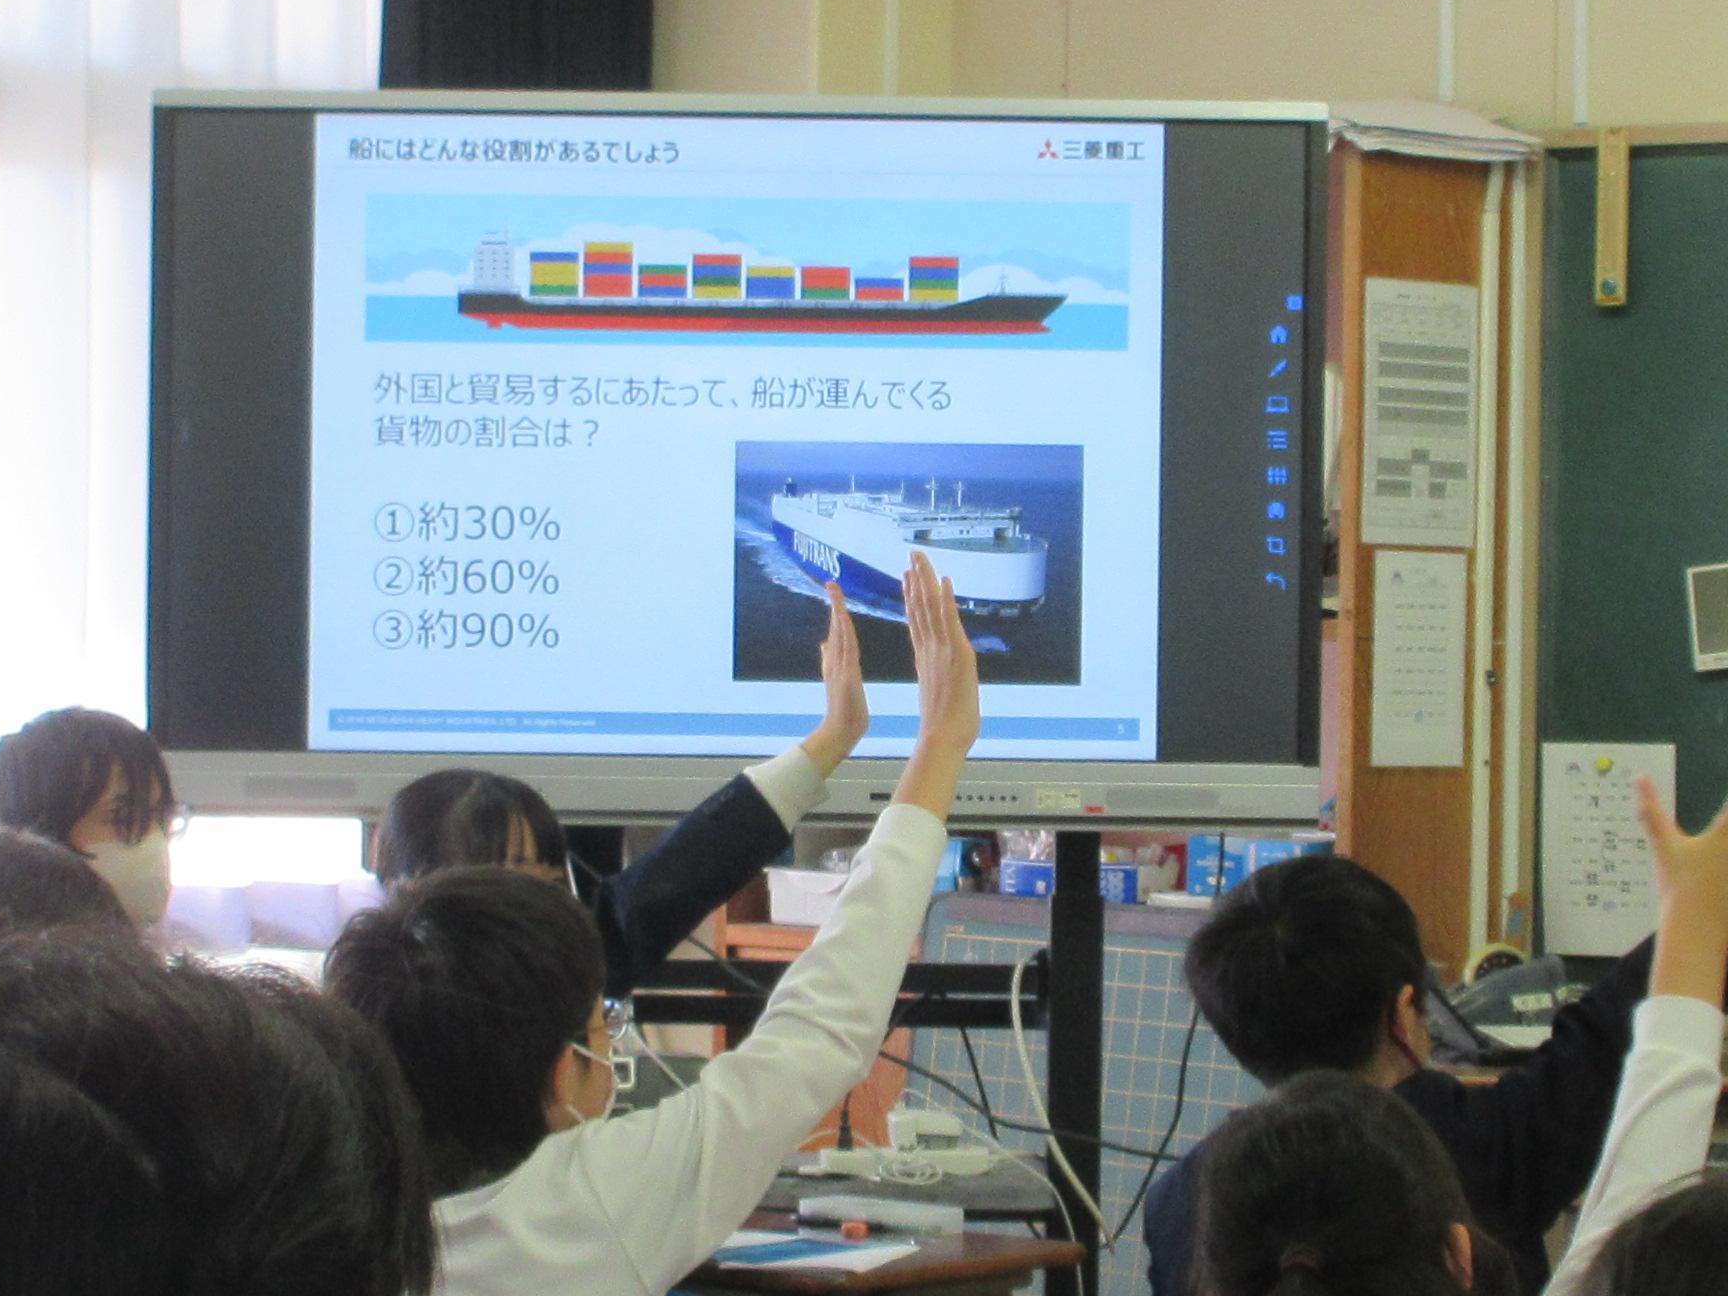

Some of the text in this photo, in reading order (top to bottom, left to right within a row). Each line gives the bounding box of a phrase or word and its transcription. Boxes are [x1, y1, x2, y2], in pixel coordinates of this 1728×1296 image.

[349, 137, 680, 165] 船にはどんな役割があるでしょう
[373, 372, 953, 411] 外国と貿易するにあたって、船が運んでくる
